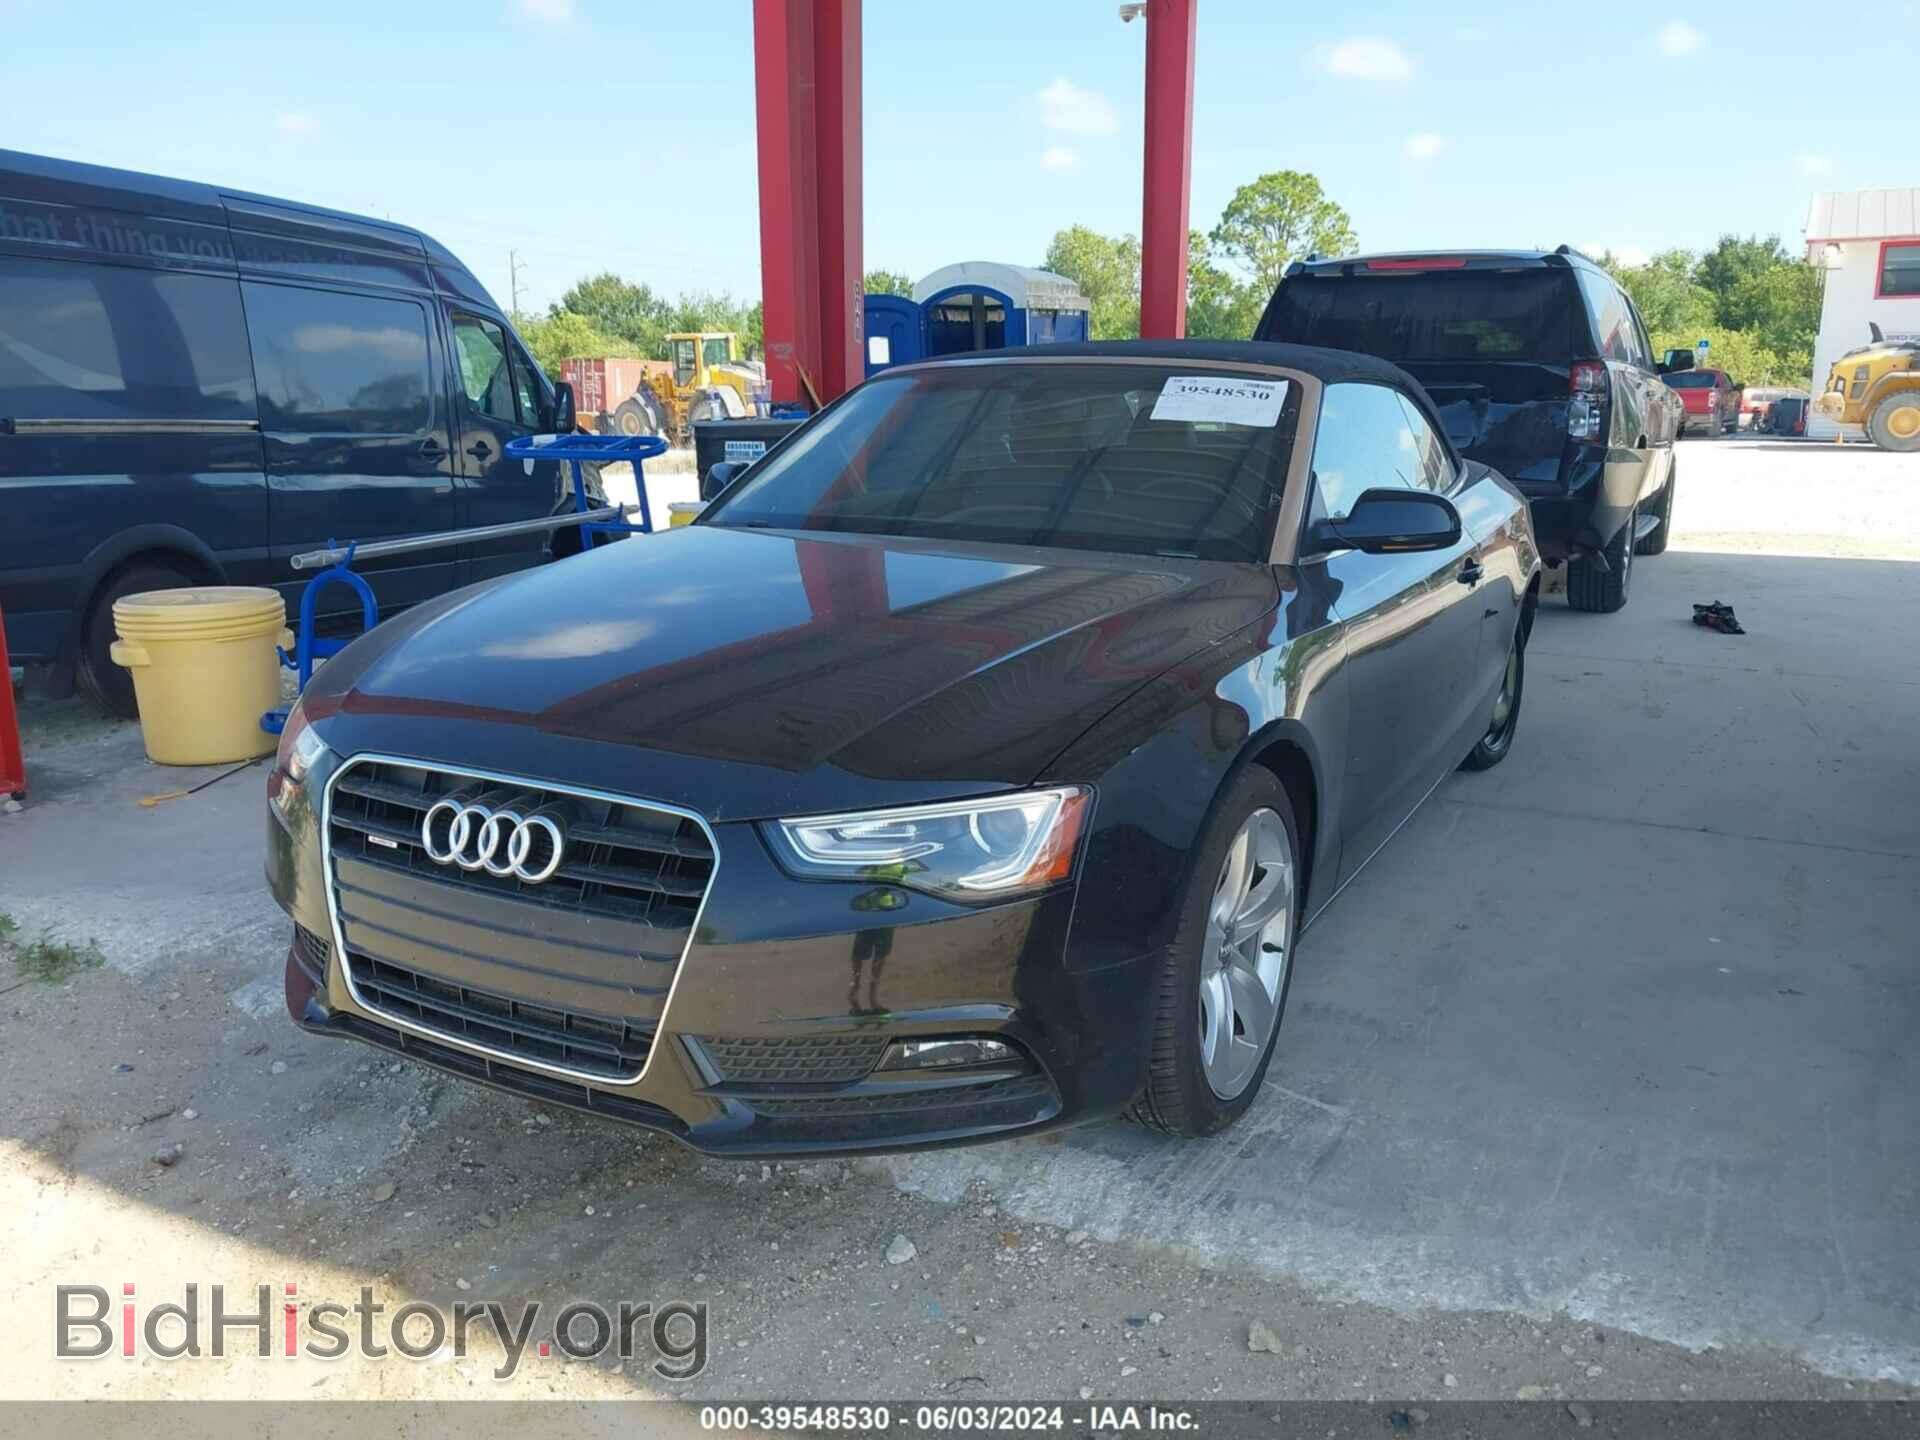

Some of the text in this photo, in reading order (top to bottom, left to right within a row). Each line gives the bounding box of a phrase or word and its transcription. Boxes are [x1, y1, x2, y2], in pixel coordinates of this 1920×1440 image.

[74, 213, 170, 268] thing
[178, 234, 237, 272] you
[1176, 384, 1271, 400] 39548530
